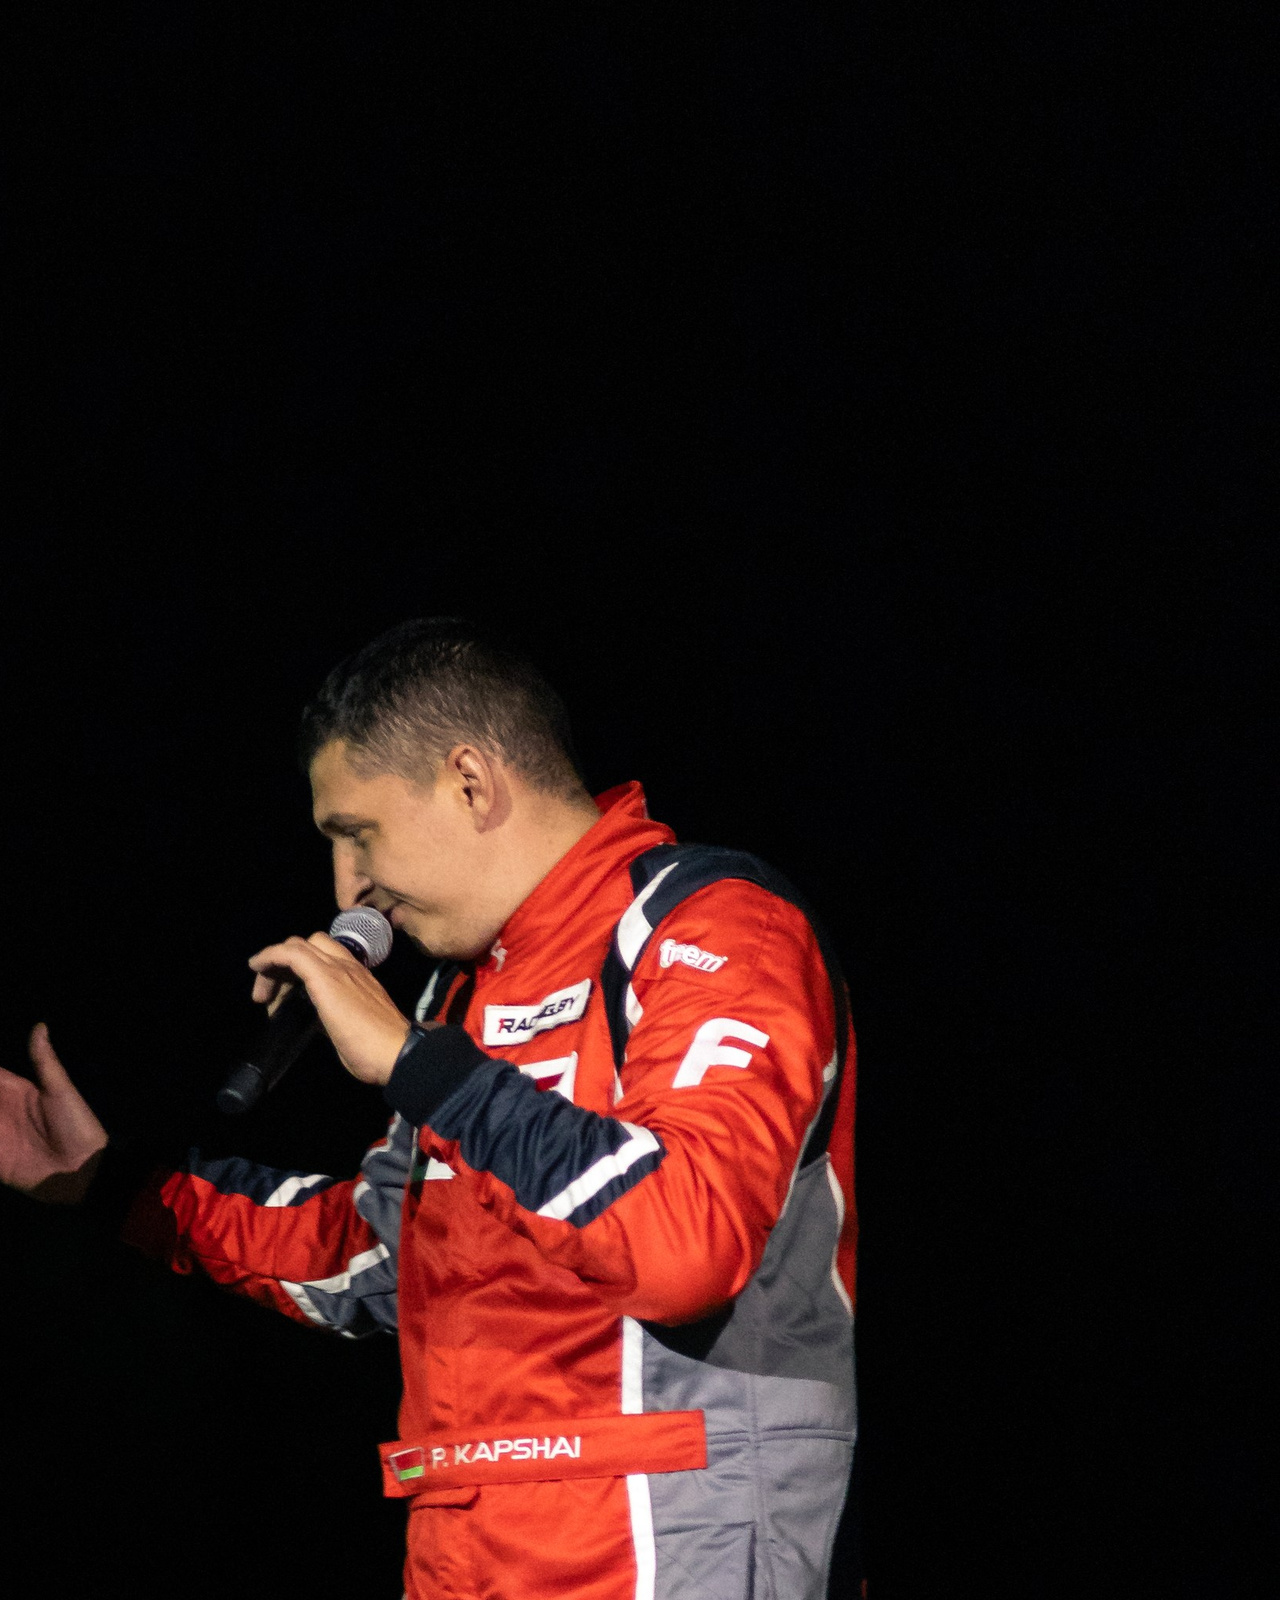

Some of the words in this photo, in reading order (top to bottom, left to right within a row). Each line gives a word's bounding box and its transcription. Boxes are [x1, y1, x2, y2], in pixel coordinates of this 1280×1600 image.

[672, 1017, 770, 1089] F
[432, 1447, 449, 1469] P.
[454, 1436, 581, 1466] KAPSHAI
